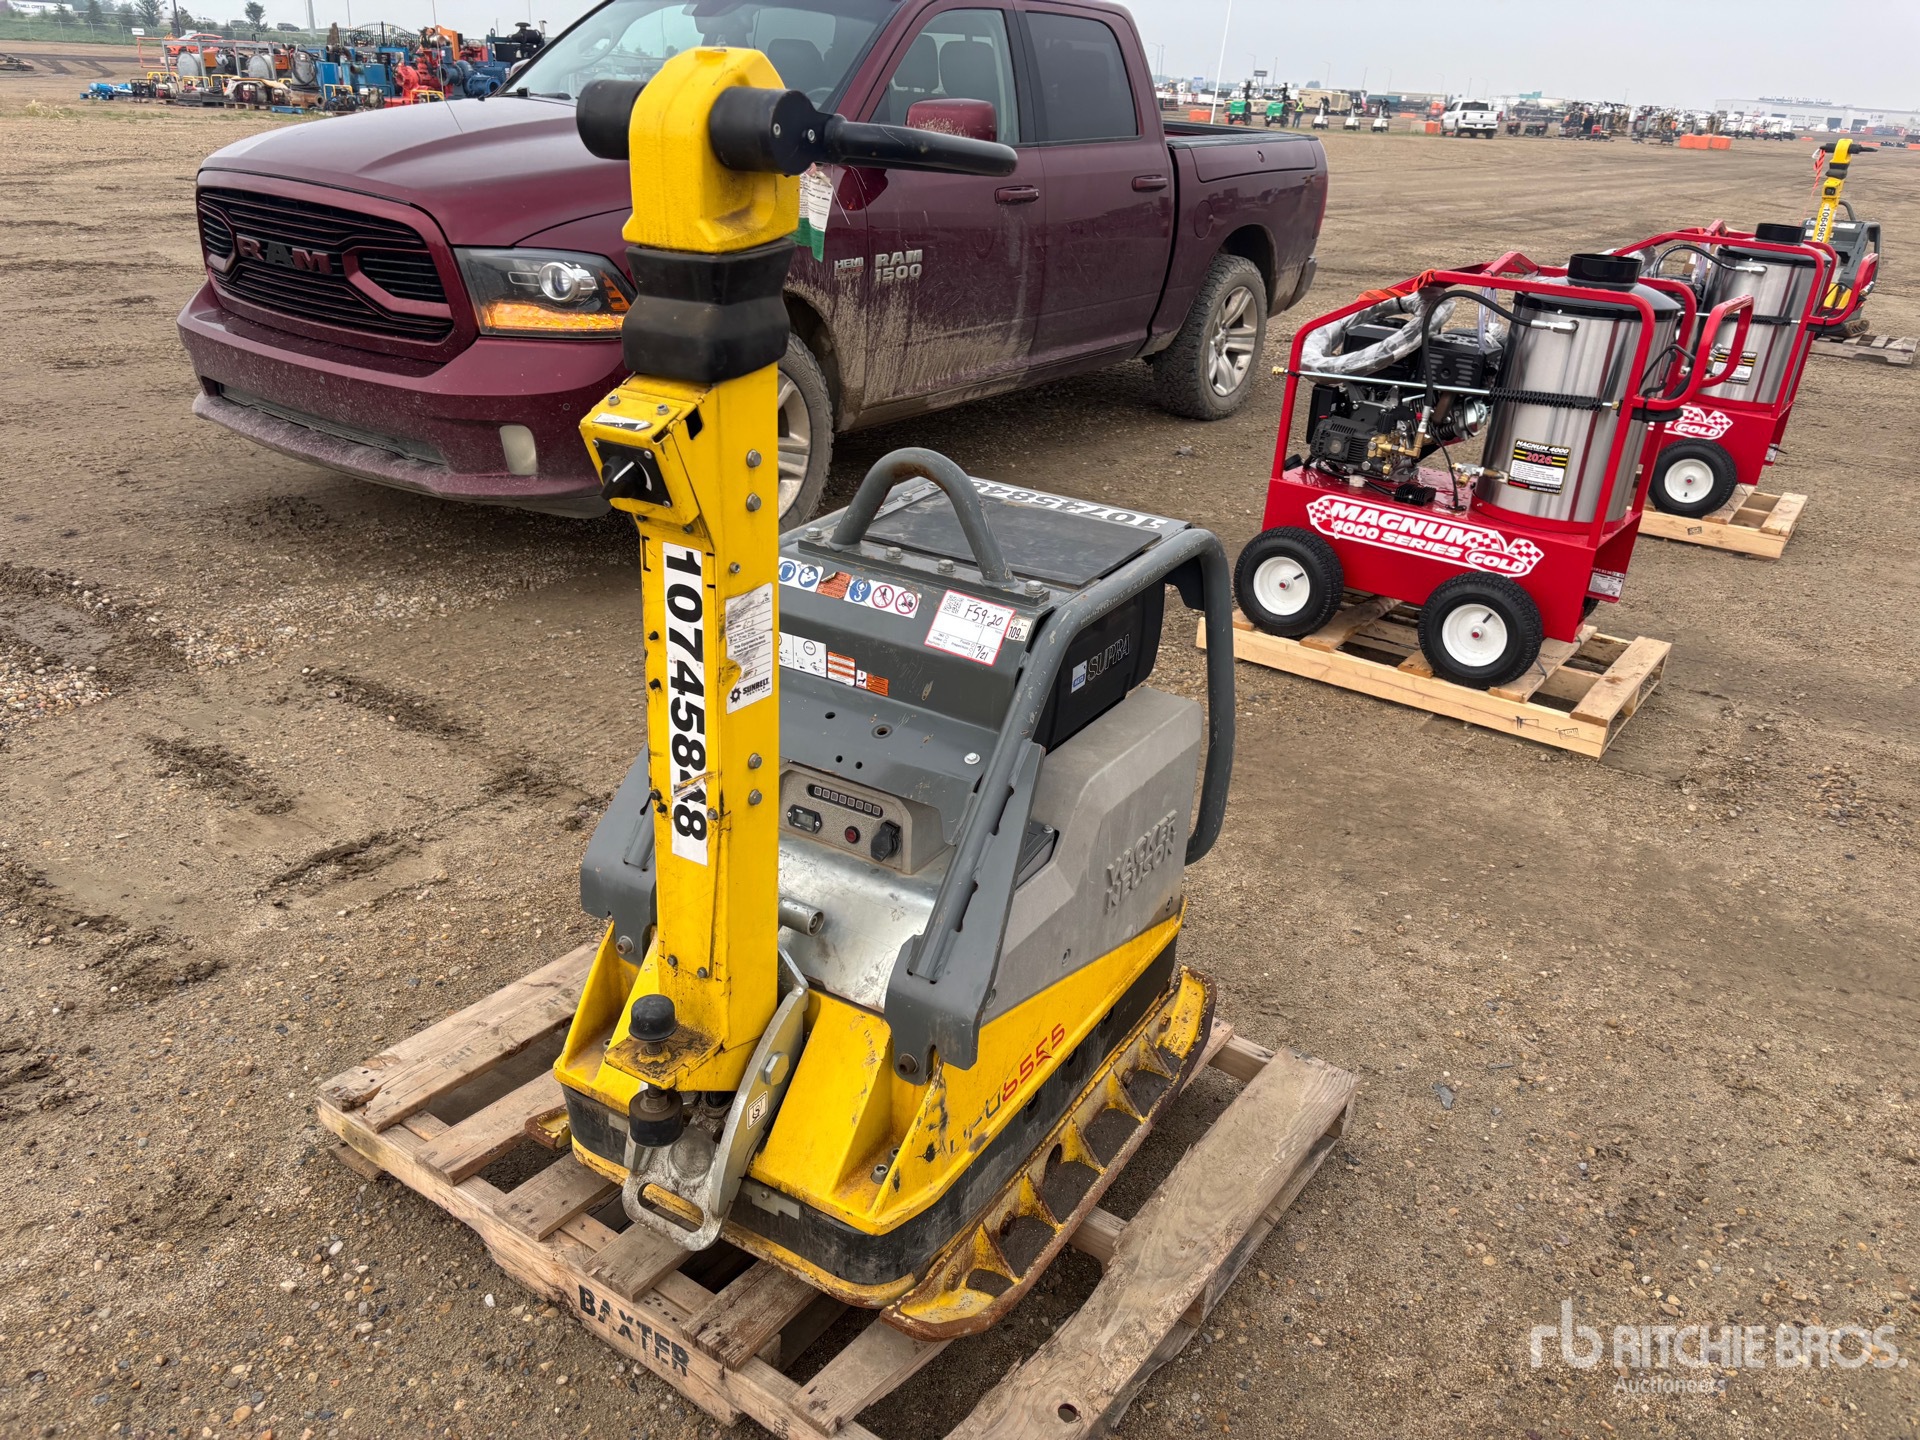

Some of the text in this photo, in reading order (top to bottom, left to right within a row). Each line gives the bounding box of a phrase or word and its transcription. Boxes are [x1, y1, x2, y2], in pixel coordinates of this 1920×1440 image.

[236, 233, 333, 276] RAM
[834, 257, 864, 269] HEMI
[875, 249, 923, 268] RAM
[875, 264, 922, 281] 1500
[1677, 424, 1720, 436] GOLD
[1516, 440, 1549, 452] MAGNUM
[1525, 451, 1553, 465] 2026
[1331, 500, 1475, 548] MAGNUM
[1332, 519, 1465, 559] 4000 SERIES
[1468, 551, 1526, 573] GOLD
[1008, 626, 1022, 640] 109
[1087, 633, 1130, 681] SUPRA
[666, 550, 708, 841] 10745848
[743, 677, 769, 695] SUNBELT
[578, 1284, 690, 1377] BAXTER
